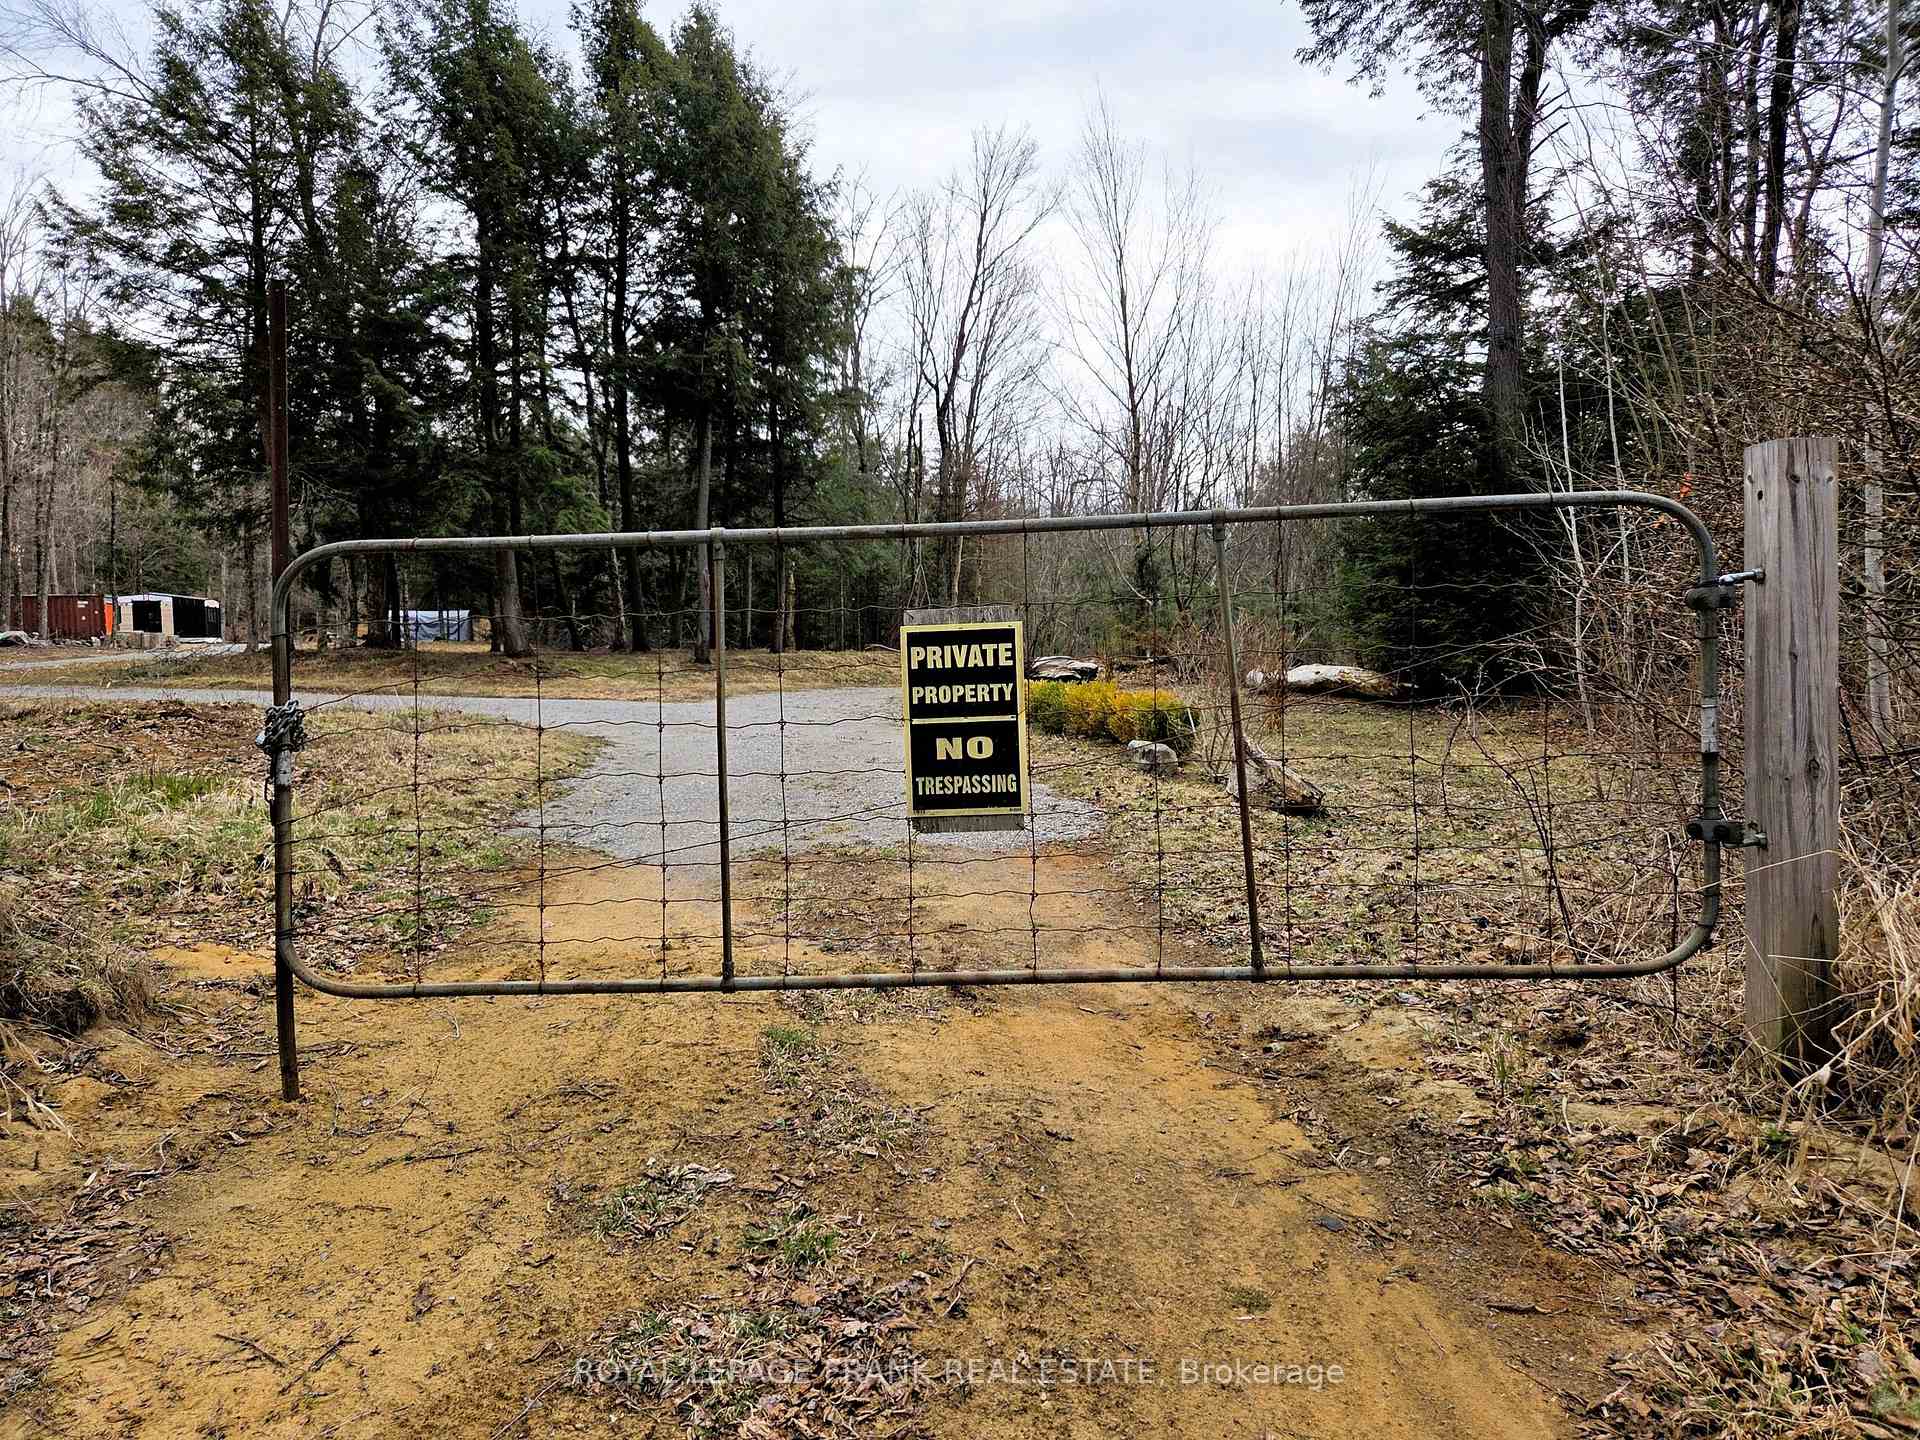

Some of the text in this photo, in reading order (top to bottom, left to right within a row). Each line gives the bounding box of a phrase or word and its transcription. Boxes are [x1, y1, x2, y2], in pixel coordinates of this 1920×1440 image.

[910, 643, 1014, 670] PRIVATE
[911, 682, 1014, 705] PROPERTY
[935, 736, 994, 761] NO
[916, 774, 1017, 796] TRESPASSING
